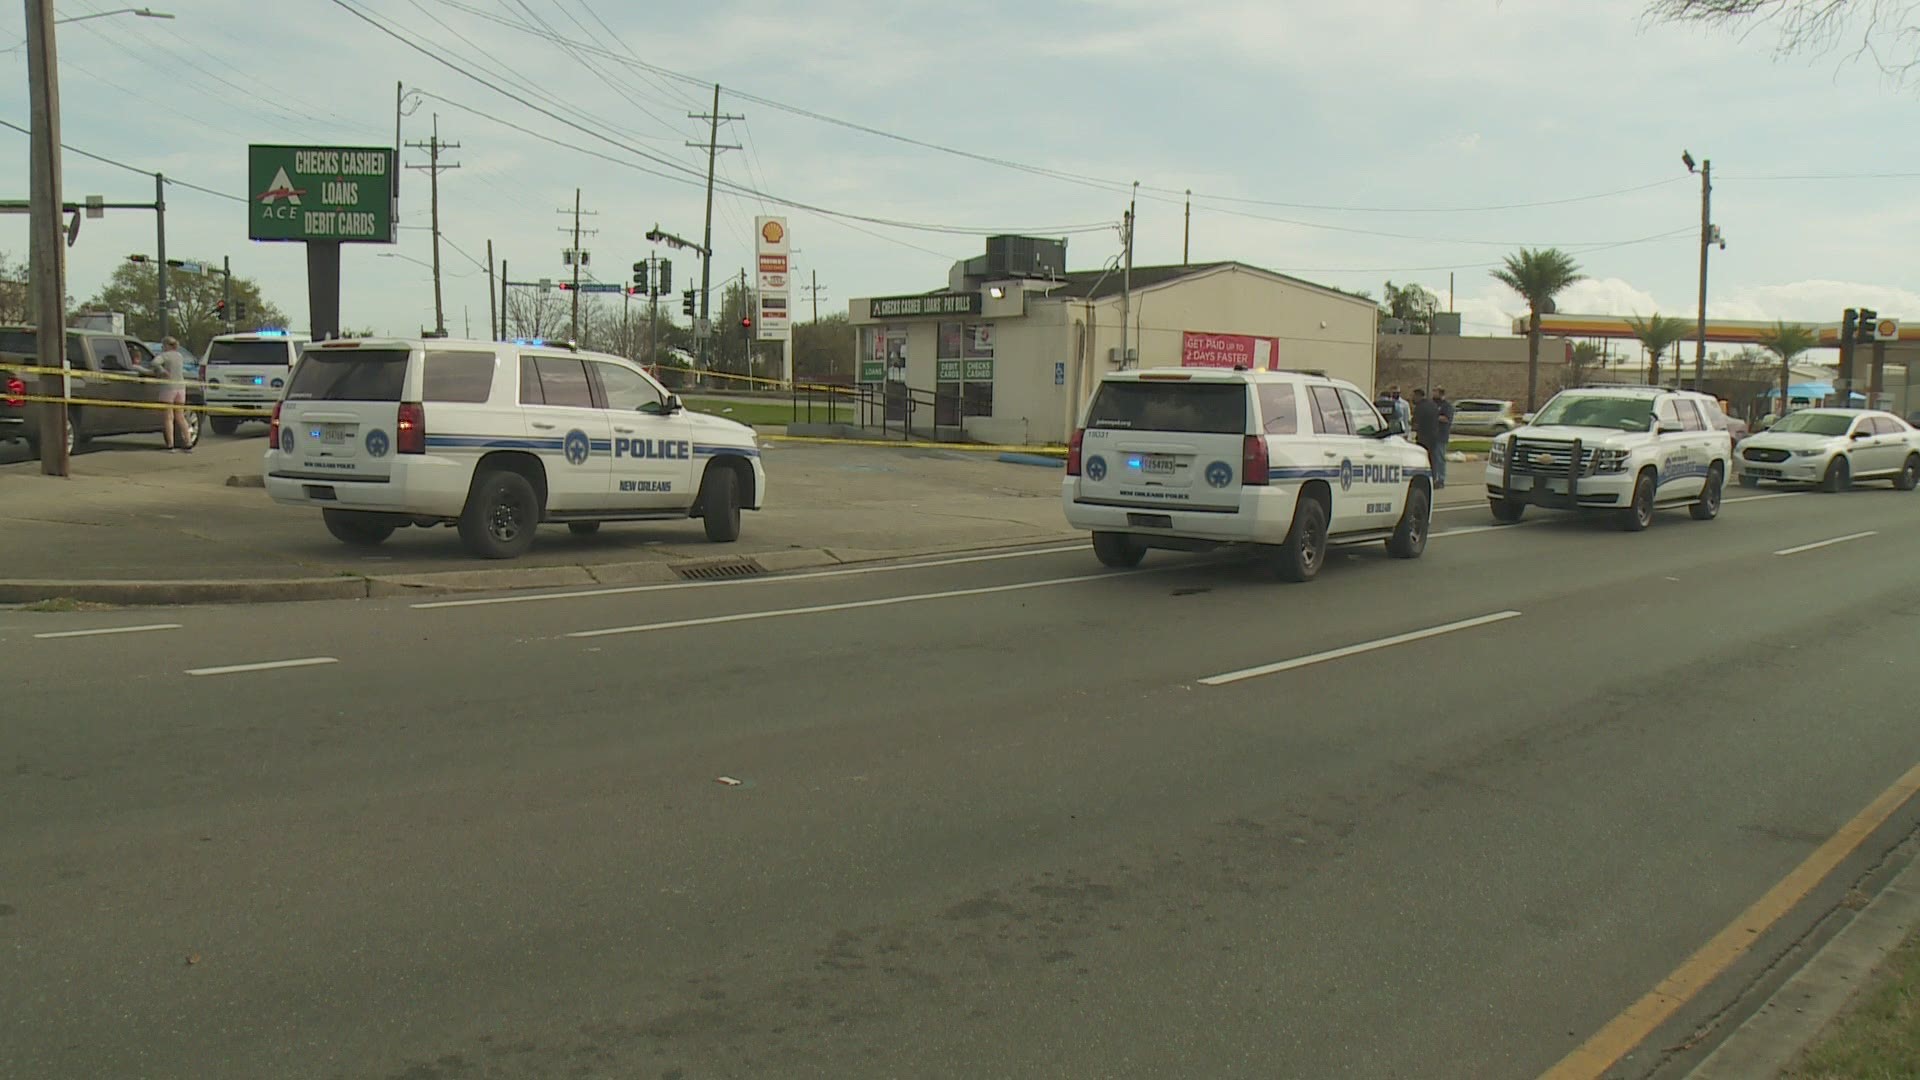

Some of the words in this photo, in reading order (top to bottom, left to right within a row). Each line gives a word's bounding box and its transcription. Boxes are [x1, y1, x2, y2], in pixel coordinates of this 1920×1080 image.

[295, 151, 339, 174] CHECKS
[341, 152, 385, 175] CASHED
[321, 181, 358, 205] LOANS
[262, 206, 298, 219] ACE
[304, 212, 336, 235] DEBIT
[338, 213, 375, 235] CARDS
[882, 300, 901, 315] CHECKS
[901, 299, 920, 314] CASHED
[924, 297, 941, 312] LOANS
[944, 296, 955, 312] PAY
[955, 295, 970, 311] BILLS
[1187, 338, 1203, 349] GET
[1206, 339, 1225, 350] PAID
[1236, 343, 1244, 351] TO
[1186, 351, 1192, 360] 2
[1194, 351, 1215, 361] DAYS
[1217, 352, 1249, 363] FASTER
[865, 367, 882, 375] LOANS
[941, 362, 958, 370] DEBIT
[967, 362, 990, 370] CHECKS
[966, 370, 991, 378] CASHED
[615, 438, 689, 459] POLICE
[1364, 464, 1400, 483] POLICE
[619, 480, 637, 491] NEW
[638, 480, 671, 492] ORLEANS
